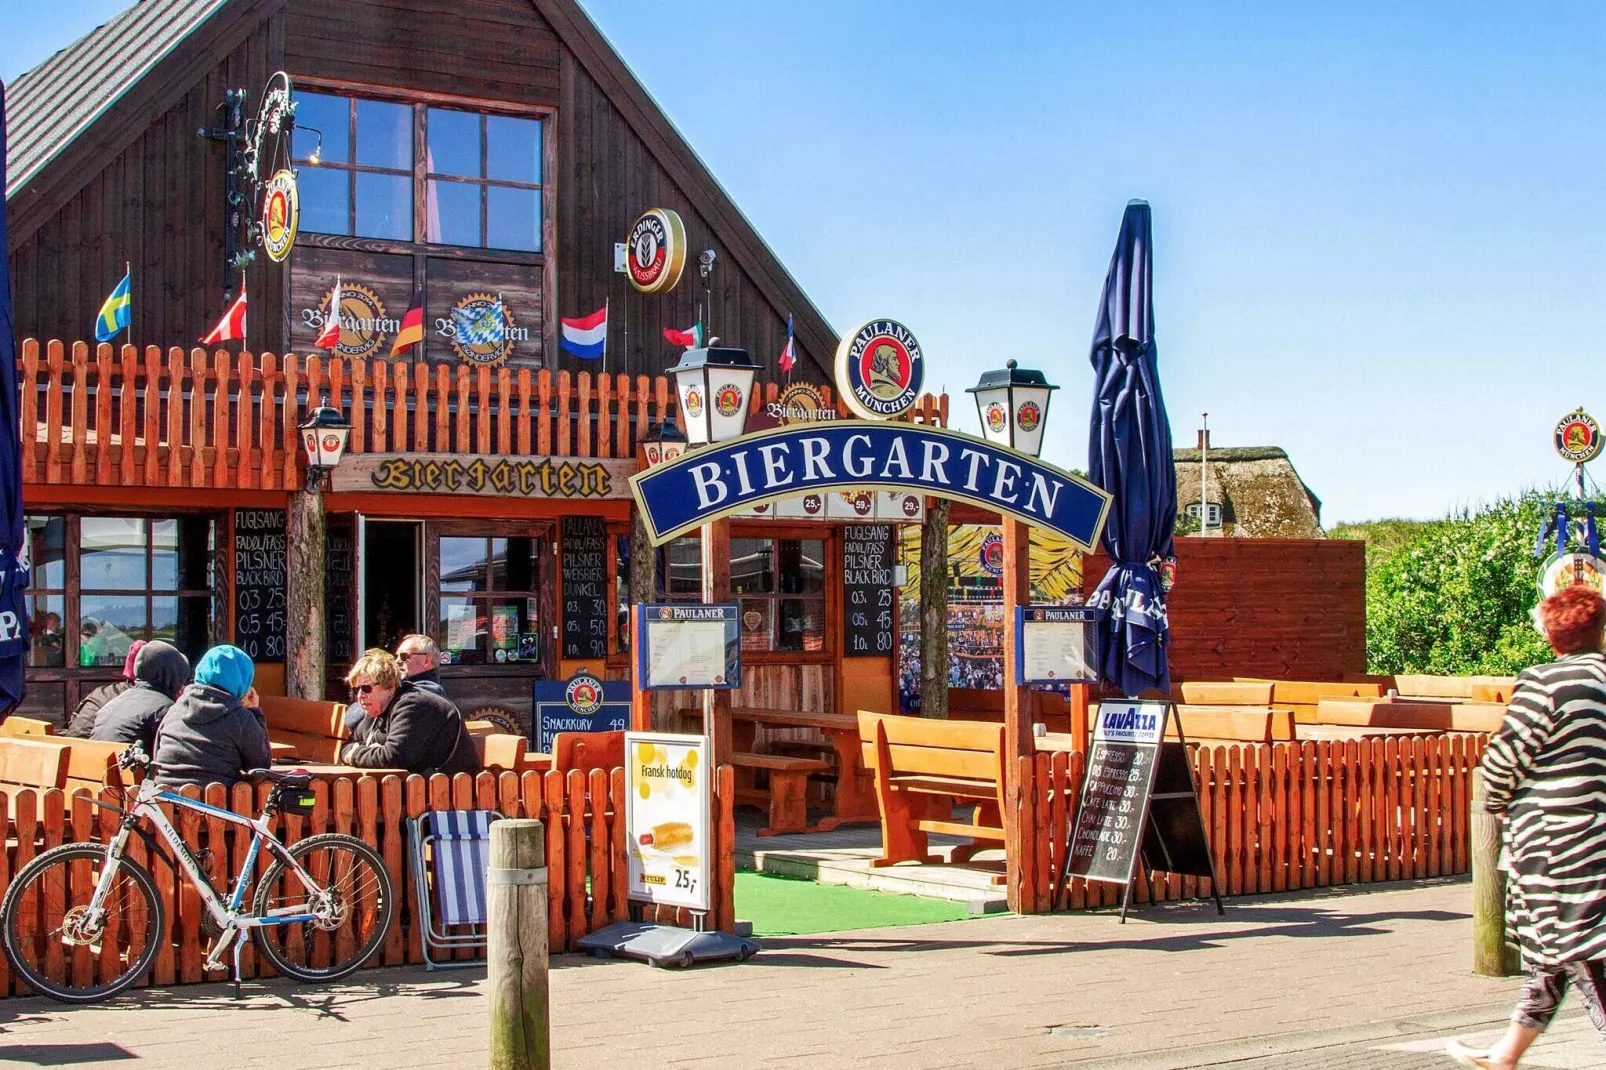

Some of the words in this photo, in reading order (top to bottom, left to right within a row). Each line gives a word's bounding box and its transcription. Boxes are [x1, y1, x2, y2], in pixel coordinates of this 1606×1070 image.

[630, 218, 664, 249] ERDINGER
[301, 308, 400, 333] Birgarten
[850, 322, 920, 363] PAULANER
[855, 385, 916, 414] MÜNCHEN
[766, 402, 836, 421] Biergarten
[1556, 414, 1597, 435] PAULANER
[371, 458, 612, 497] Biergarten
[687, 434, 1064, 518] BIERGARTEN
[805, 500, 821, 509] 25,-
[855, 501, 871, 510] 59,-
[904, 502, 920, 511] 29,-
[235, 511, 285, 529] FUGLSANG
[844, 525, 889, 541] FUGLSANG
[235, 550, 287, 571] PILSNER
[563, 552, 602, 568] PILSNER
[844, 554, 881, 570] PILSNER
[235, 571, 262, 585] BLACK
[263, 571, 283, 585] BIRD
[844, 569, 870, 585] BLACK
[871, 569, 891, 585] BIRD
[564, 582, 601, 597] DUNKEL
[673, 608, 725, 619] PAULANER
[1045, 610, 1086, 620] PAULANER
[567, 679, 601, 694] PAULANER
[543, 716, 593, 730] SNACKKURV
[1103, 707, 1157, 730] LAVAZZA
[1095, 747, 1125, 763] ESPRESSO
[641, 764, 664, 778] Fransk
[666, 764, 692, 784] hotdog
[1102, 767, 1129, 781] ESPRESSO
[1074, 845, 1094, 857] KAFFE
[646, 875, 665, 883] TULIP
